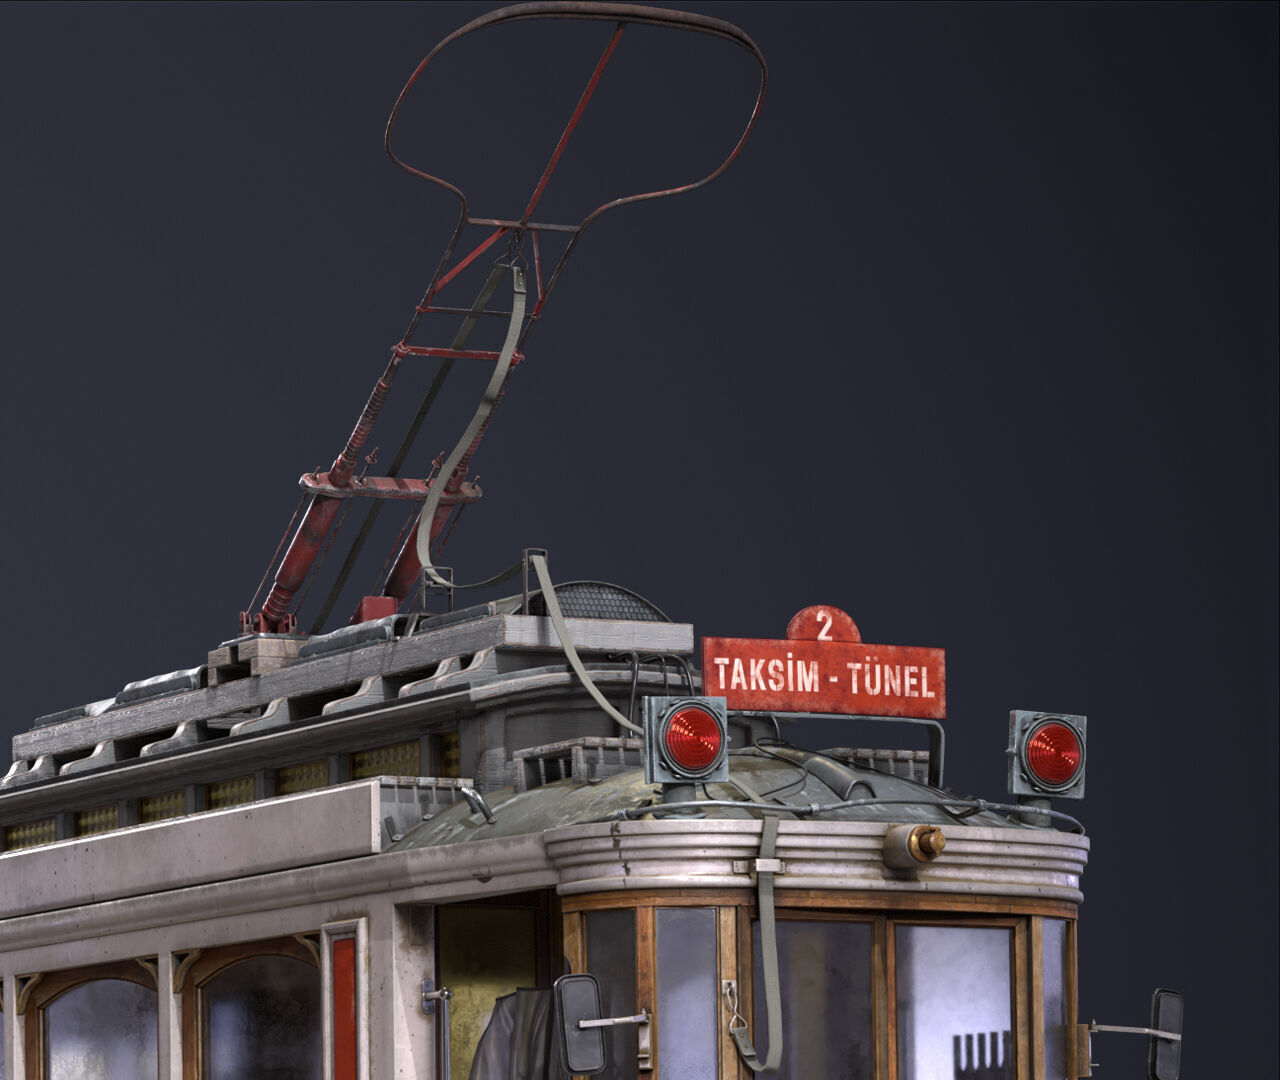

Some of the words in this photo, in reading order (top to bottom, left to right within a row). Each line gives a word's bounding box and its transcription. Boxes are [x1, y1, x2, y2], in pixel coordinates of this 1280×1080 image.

[816, 610, 833, 642] 2
[714, 652, 820, 693] TAKSİM
[846, 656, 936, 699] TÜNEL
